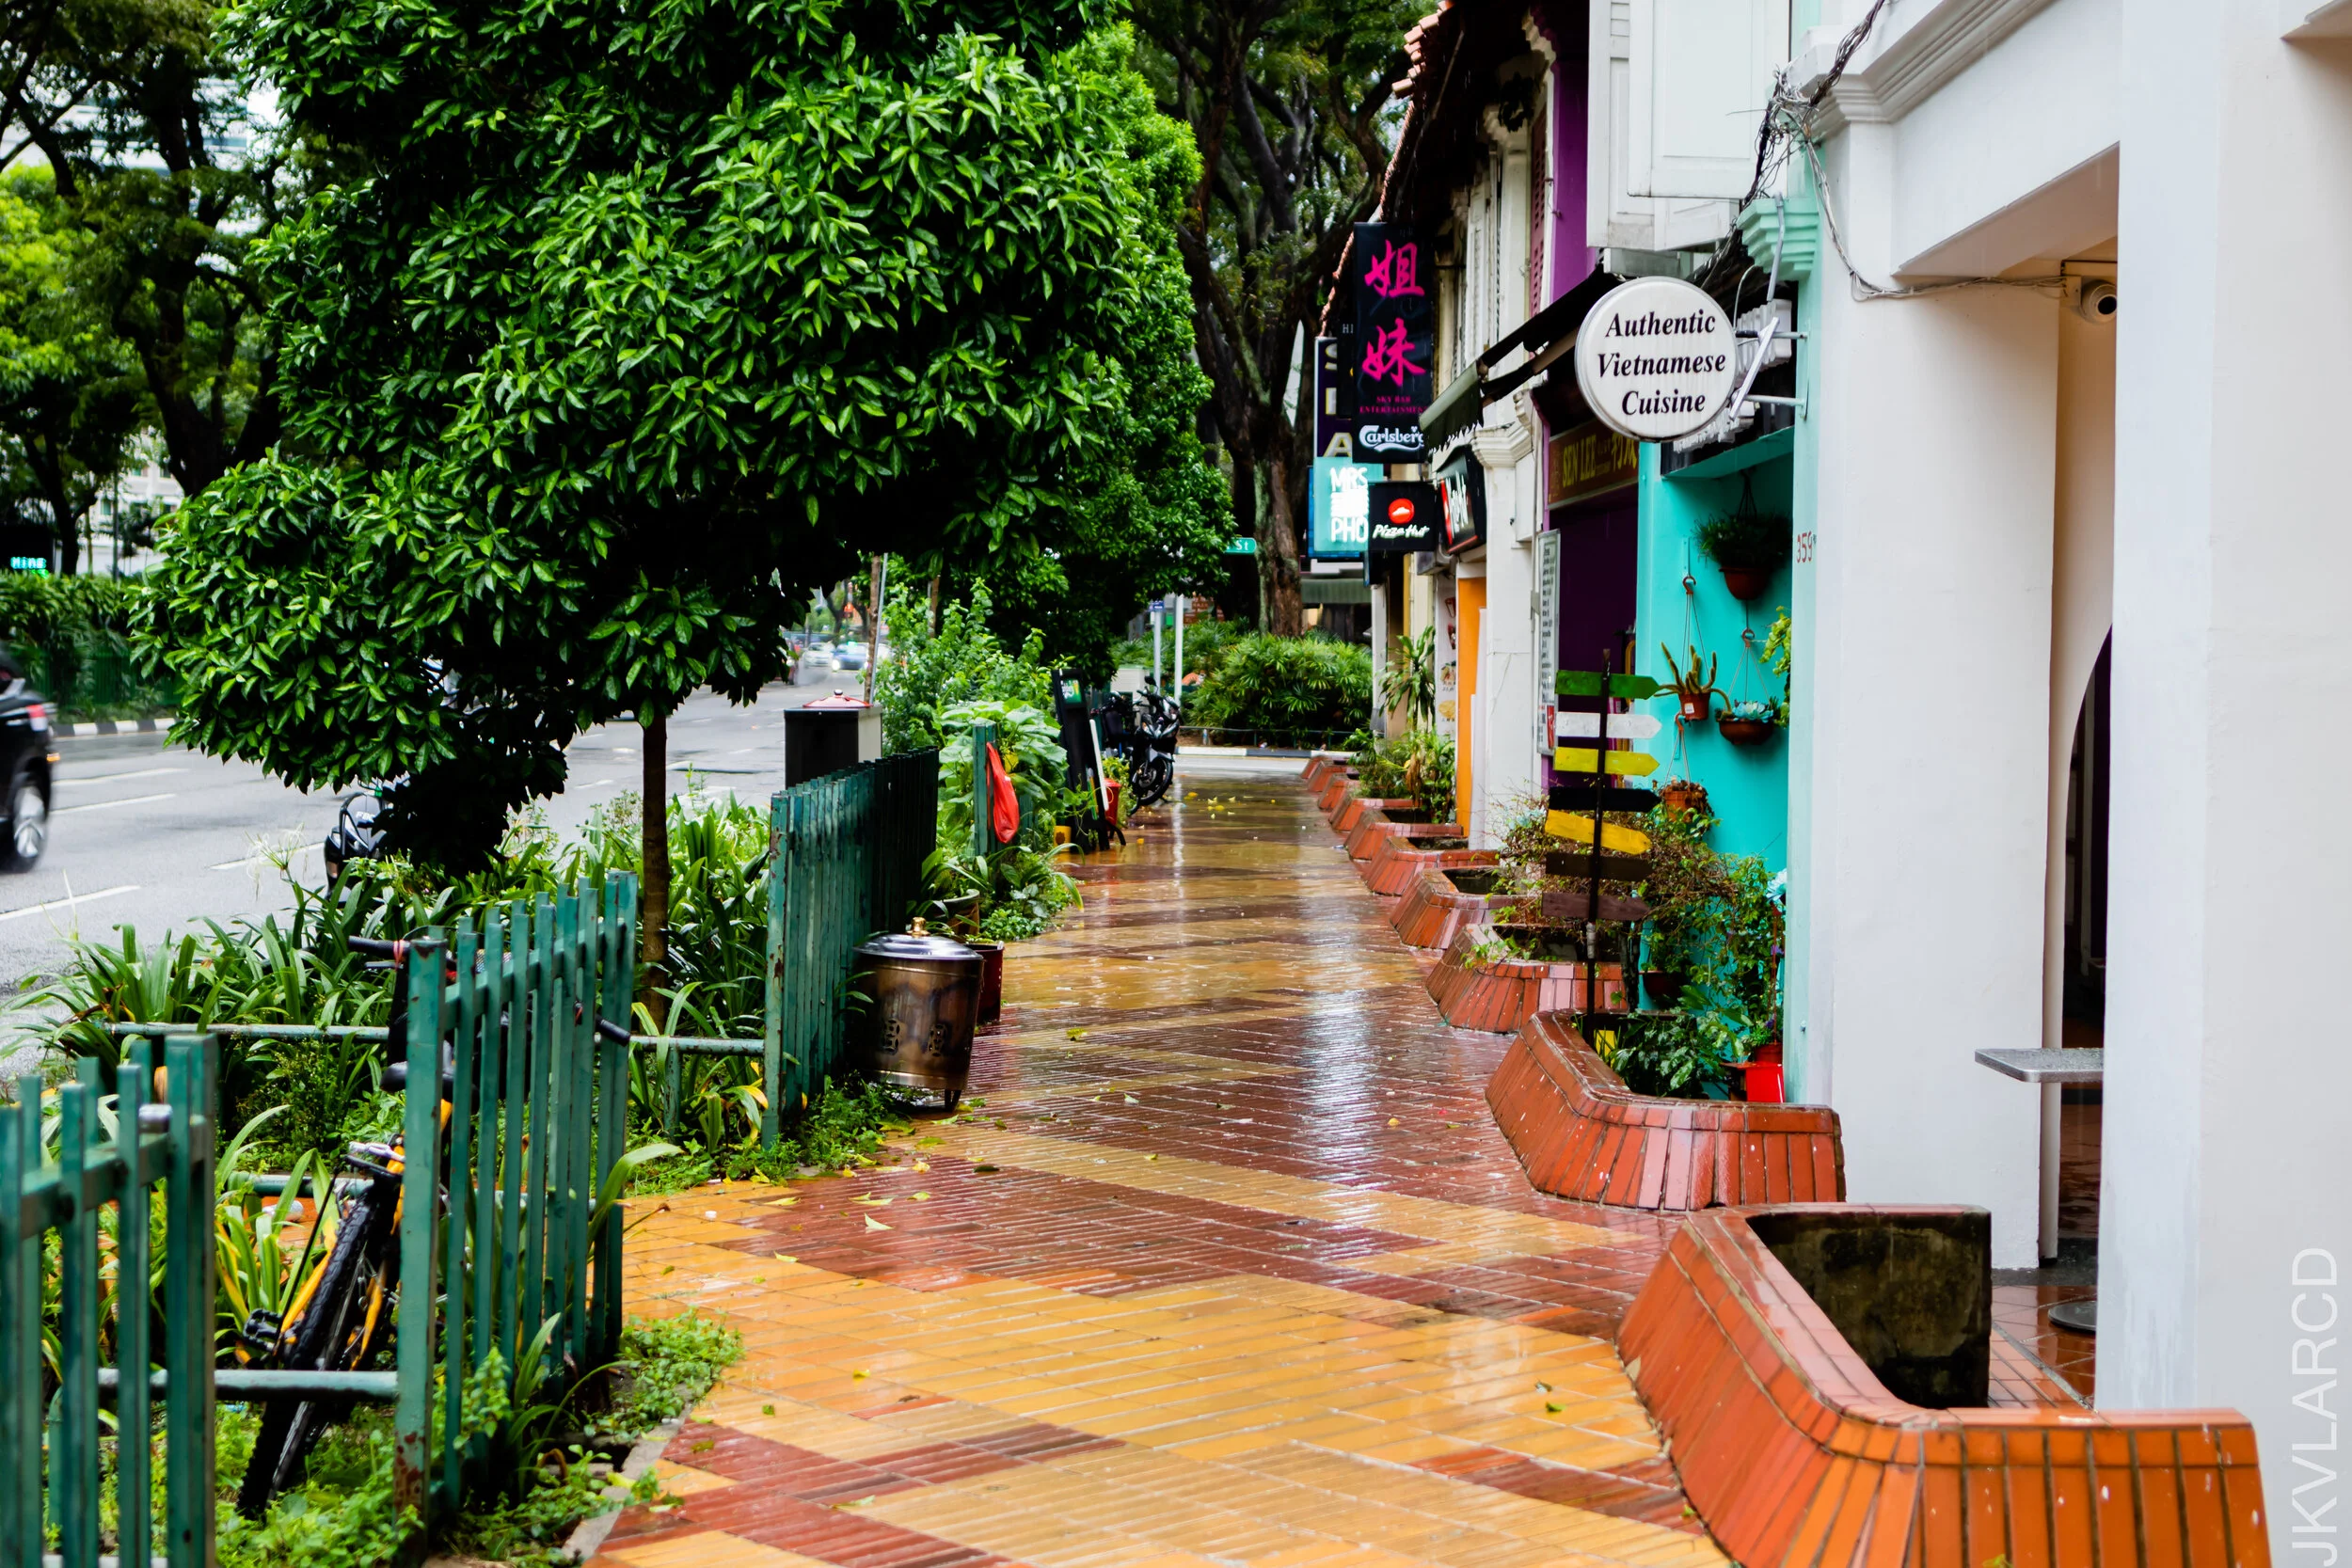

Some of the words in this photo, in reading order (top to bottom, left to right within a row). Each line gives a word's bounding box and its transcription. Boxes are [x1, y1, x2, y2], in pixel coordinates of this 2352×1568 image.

[1362, 239, 1426, 388] 姐妹
[1605, 309, 1716, 338] Authentic
[1597, 352, 1726, 378] Vietnamese
[1621, 388, 1706, 416] Cuisine
[1563, 442, 1579, 488] SEN
[1581, 434, 1597, 482] LEE
[1330, 467, 1368, 492] MRS
[1330, 516, 1368, 543] PHO
[1373, 524, 1405, 539] Pizza
[1405, 524, 1430, 538] Hut
[1235, 540, 1249, 551] St
[1796, 531, 1813, 563] 359
